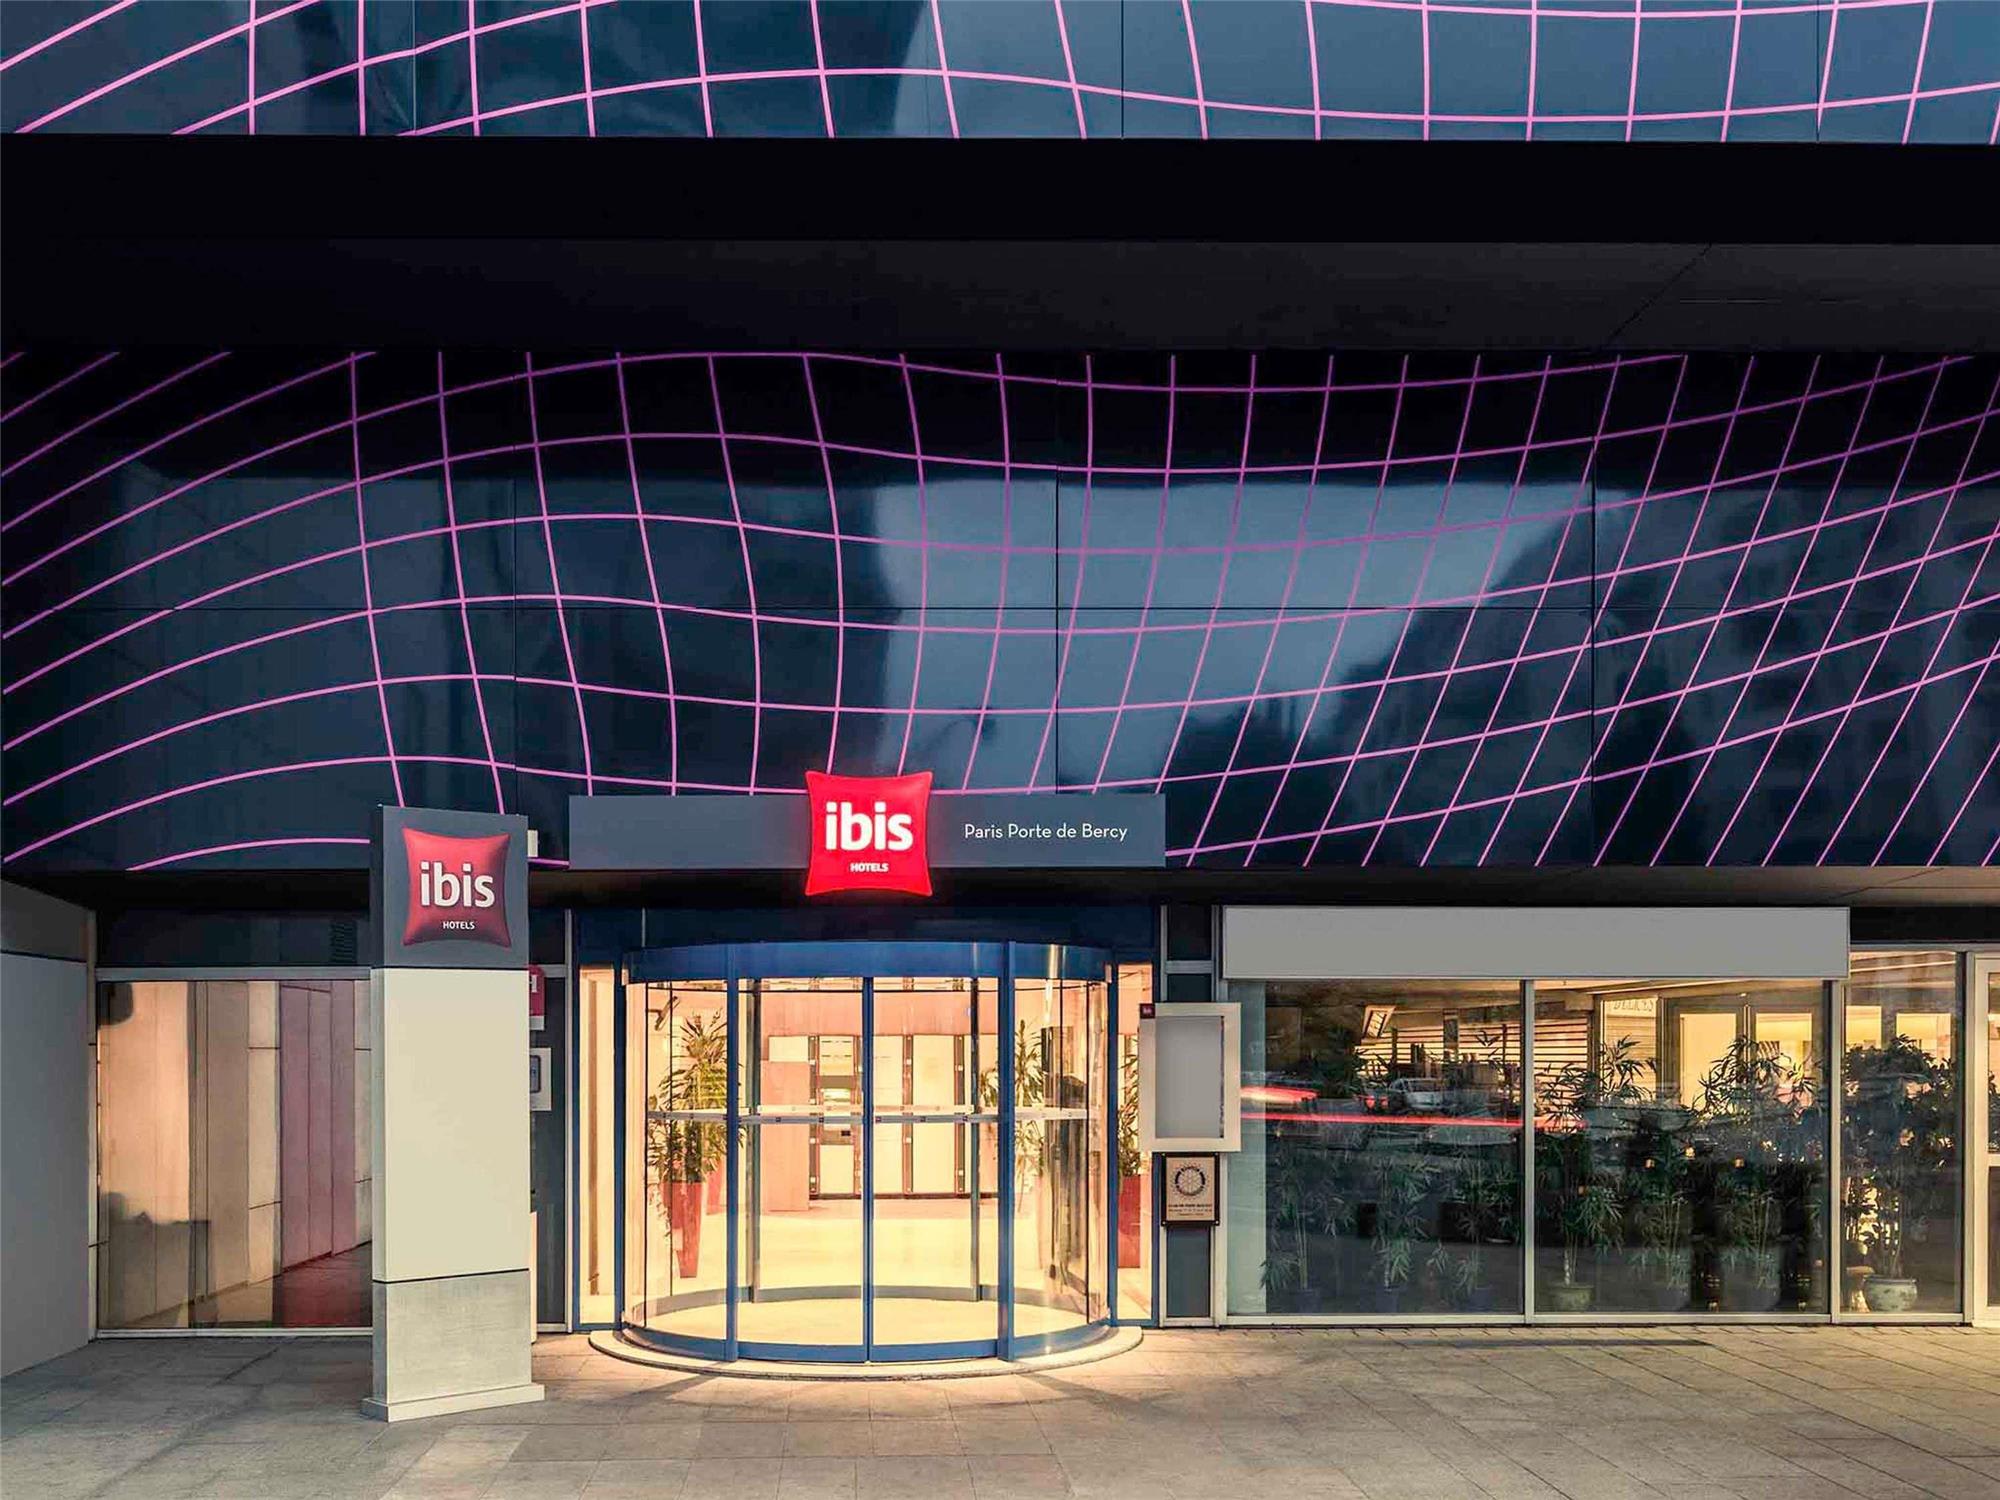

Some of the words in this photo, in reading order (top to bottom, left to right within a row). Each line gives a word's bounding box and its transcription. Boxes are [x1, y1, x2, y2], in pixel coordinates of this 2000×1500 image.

[825, 801, 914, 851] ibis
[964, 823, 1004, 839] Paris
[1008, 823, 1052, 839] Porte
[1056, 823, 1078, 839] de
[1082, 823, 1129, 843] Bercy
[850, 862, 890, 874] HOTELS
[420, 861, 495, 908] ibis
[442, 920, 476, 931] HOTELS
